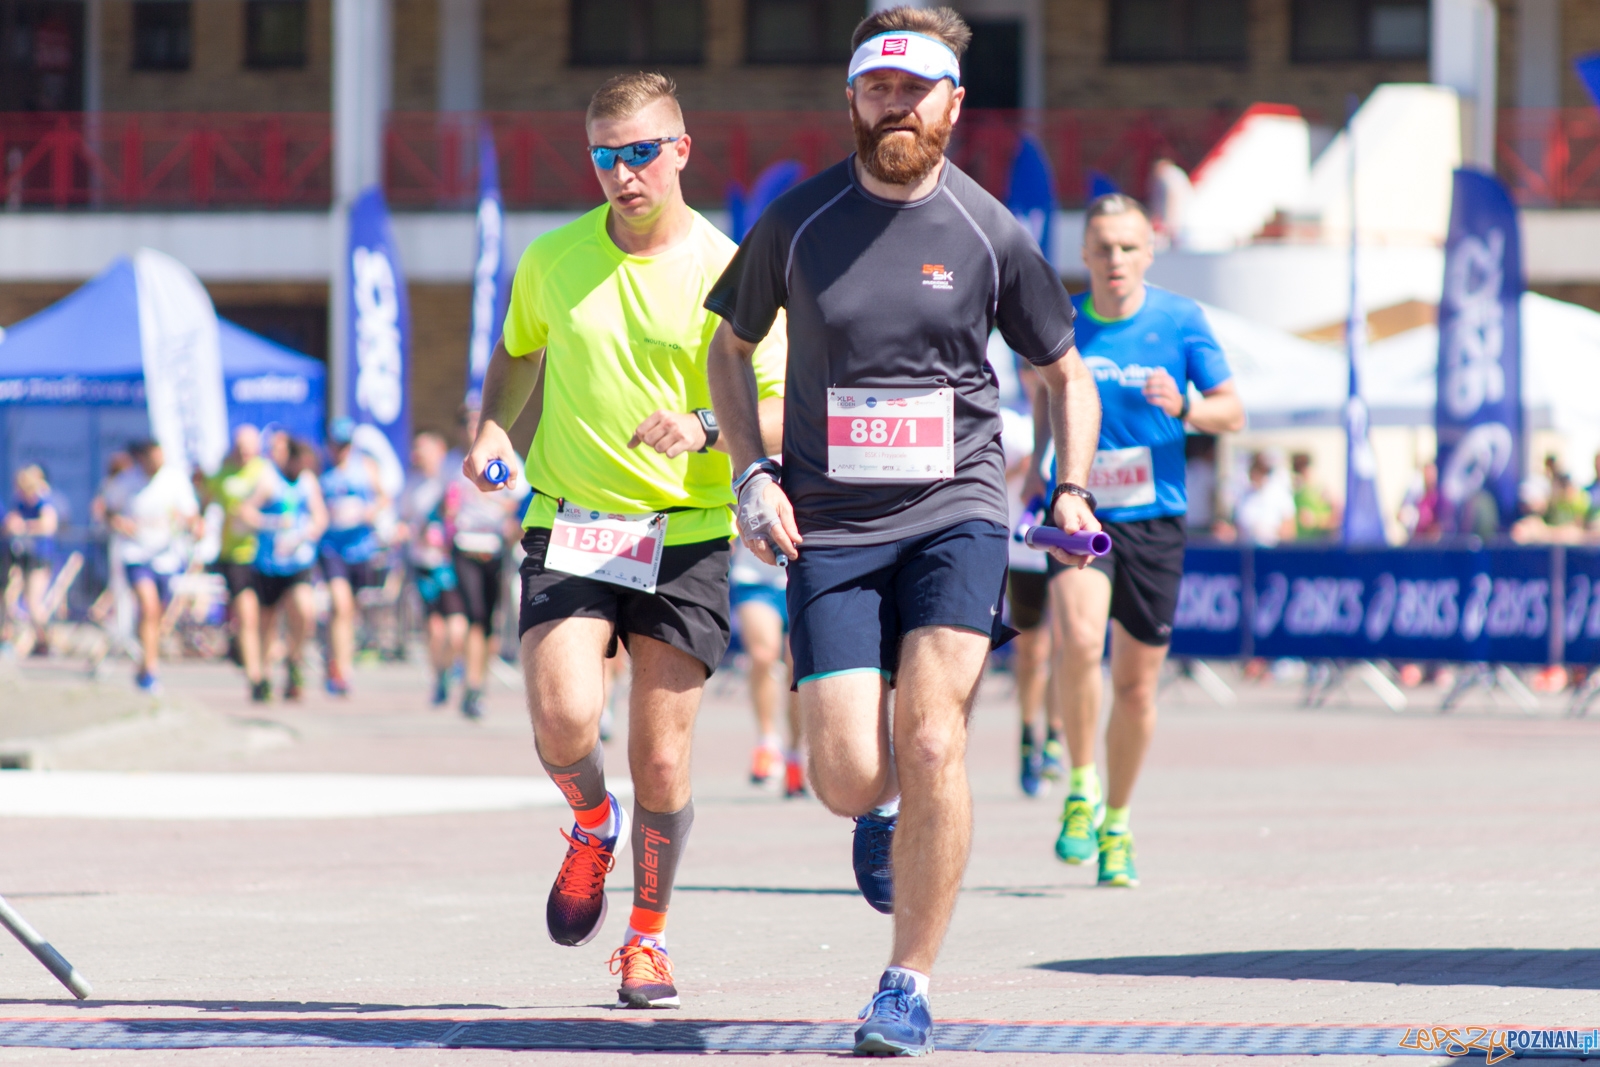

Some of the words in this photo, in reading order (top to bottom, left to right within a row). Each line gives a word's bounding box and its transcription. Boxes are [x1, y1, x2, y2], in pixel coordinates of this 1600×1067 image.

[849, 418, 918, 447] 88/1
[565, 527, 642, 559] 158/1
[639, 824, 671, 904] Kalenji
